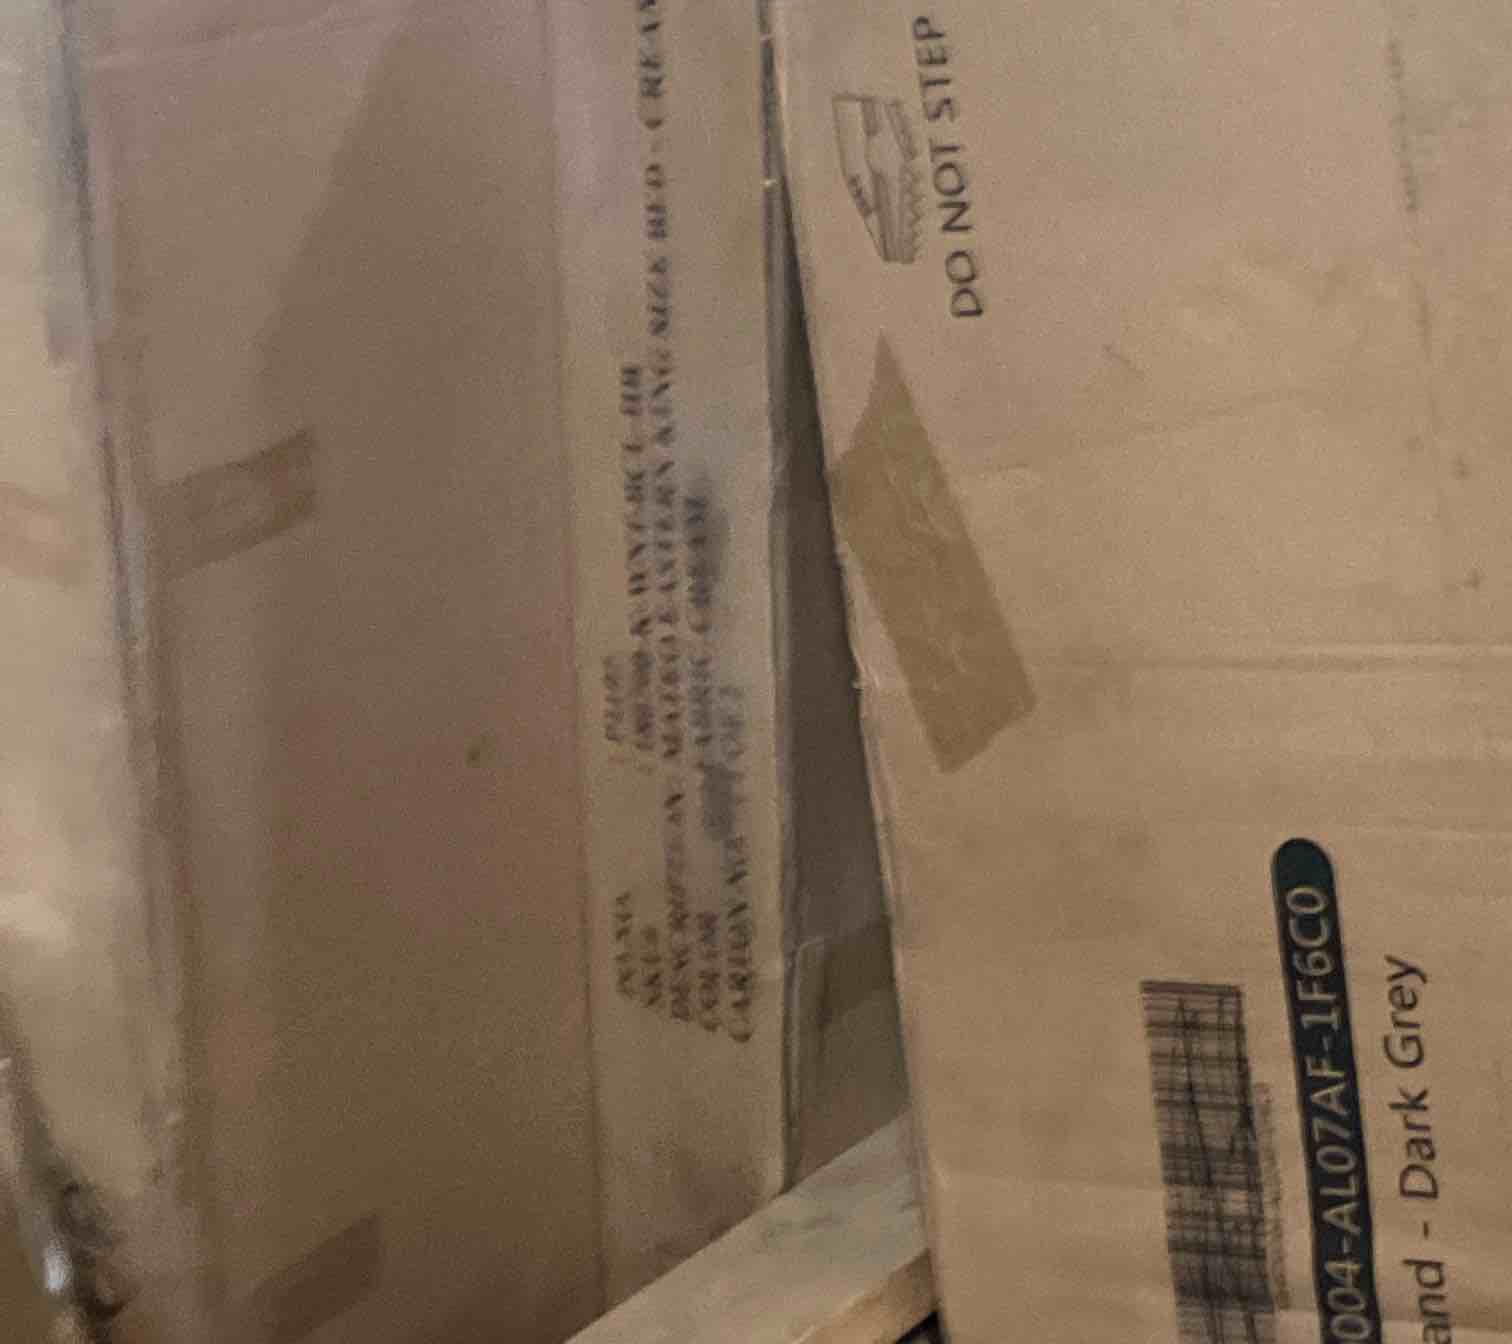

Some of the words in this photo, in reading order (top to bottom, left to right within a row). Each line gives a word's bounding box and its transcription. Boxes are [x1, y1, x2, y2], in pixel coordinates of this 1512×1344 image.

[913, 16, 960, 123] STEP
[929, 139, 973, 234] NOT
[944, 250, 984, 318] DO
[1384, 954, 1428, 1069] Grey
[1389, 1087, 1440, 1201] Dark
